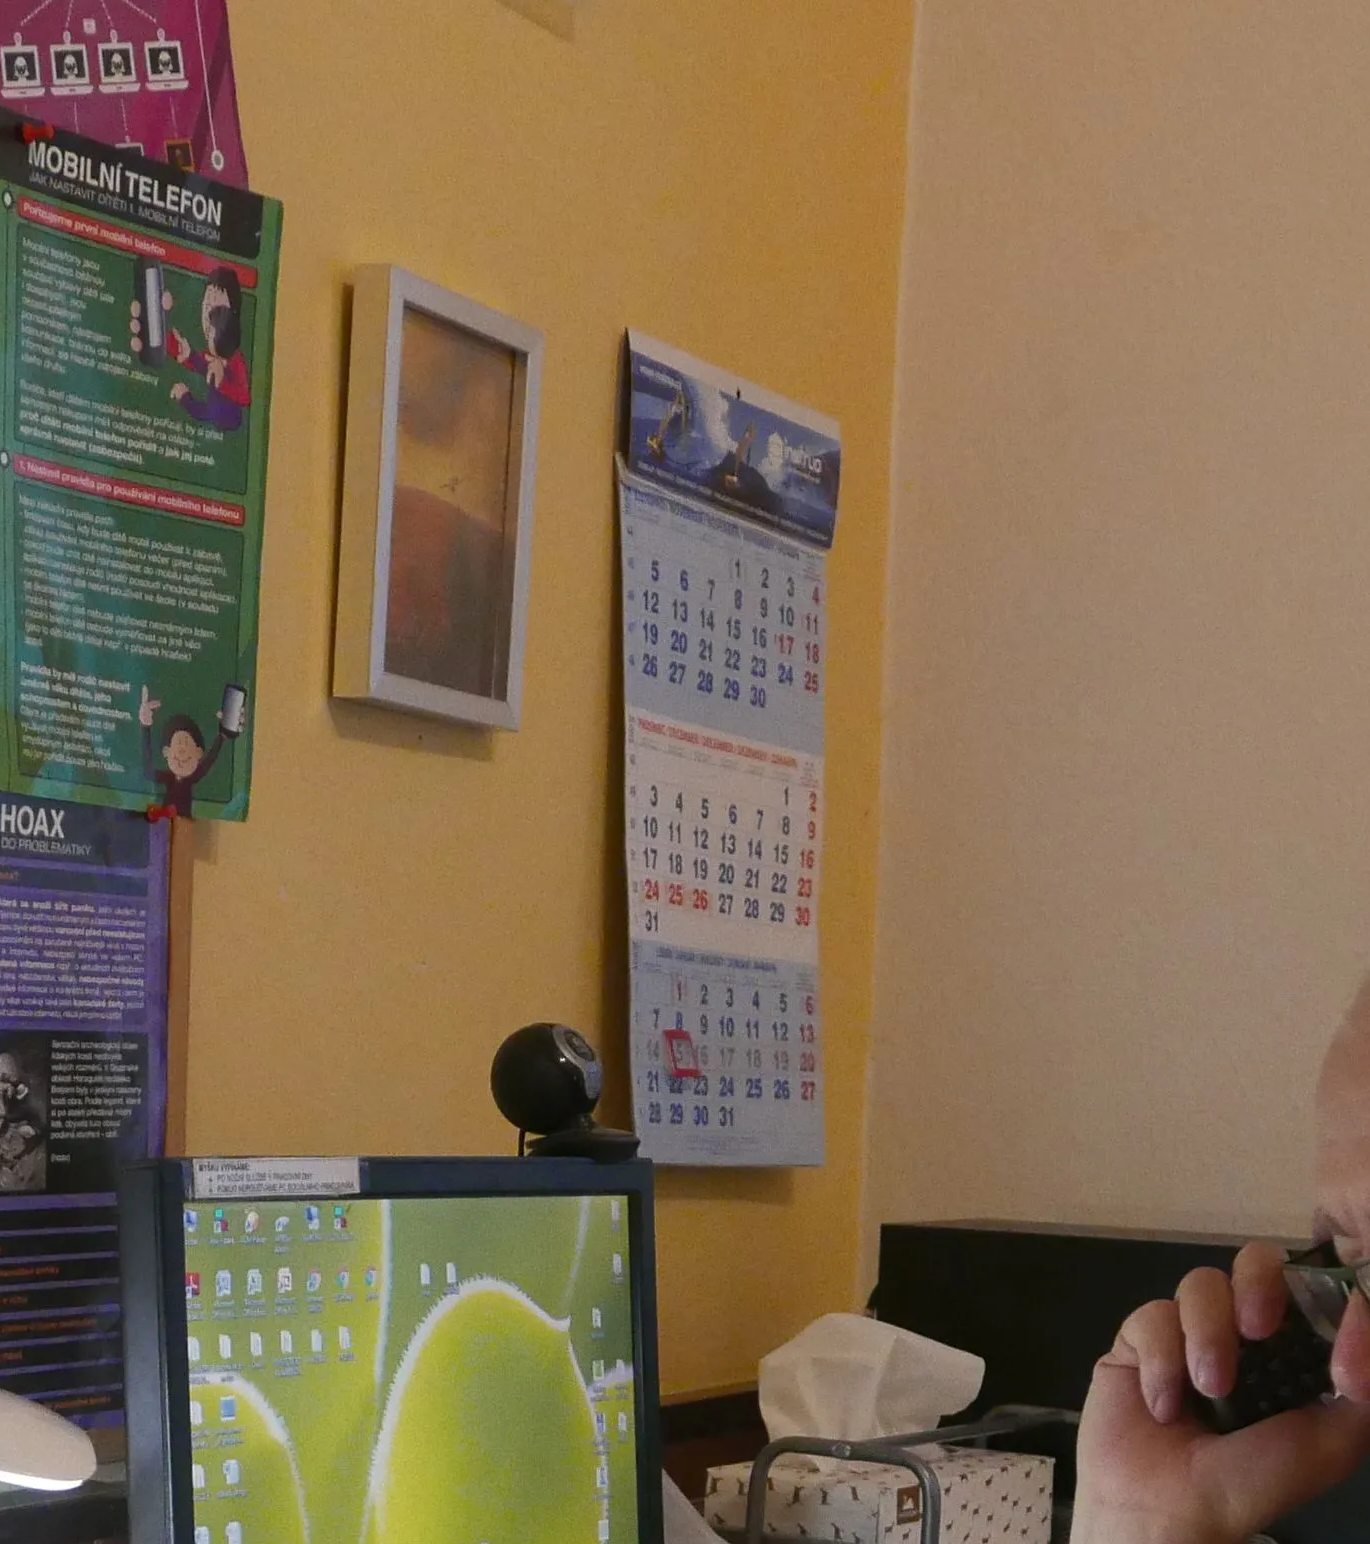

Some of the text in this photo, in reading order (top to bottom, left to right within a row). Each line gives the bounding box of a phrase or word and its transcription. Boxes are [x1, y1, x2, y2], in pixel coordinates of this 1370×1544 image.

[29, 140, 222, 226] MOBILNÍ TELEFON
[642, 590, 820, 665] 12 13 14 15 16 17 18
[778, 605, 820, 636] 10 11
[642, 621, 820, 695] 19 20 21 22 23 24 25
[642, 653, 767, 709] 26 27 28 29 30
[0, 803, 65, 838] HOAX
[1, 836, 17, 850] DO
[643, 815, 815, 870] 10 11 12 13 14 15 16
[643, 847, 813, 898] 17 18 19 20 21 22 23
[643, 879, 811, 927] 24 25 26 27 28 29 30
[644, 910, 660, 933] 31
